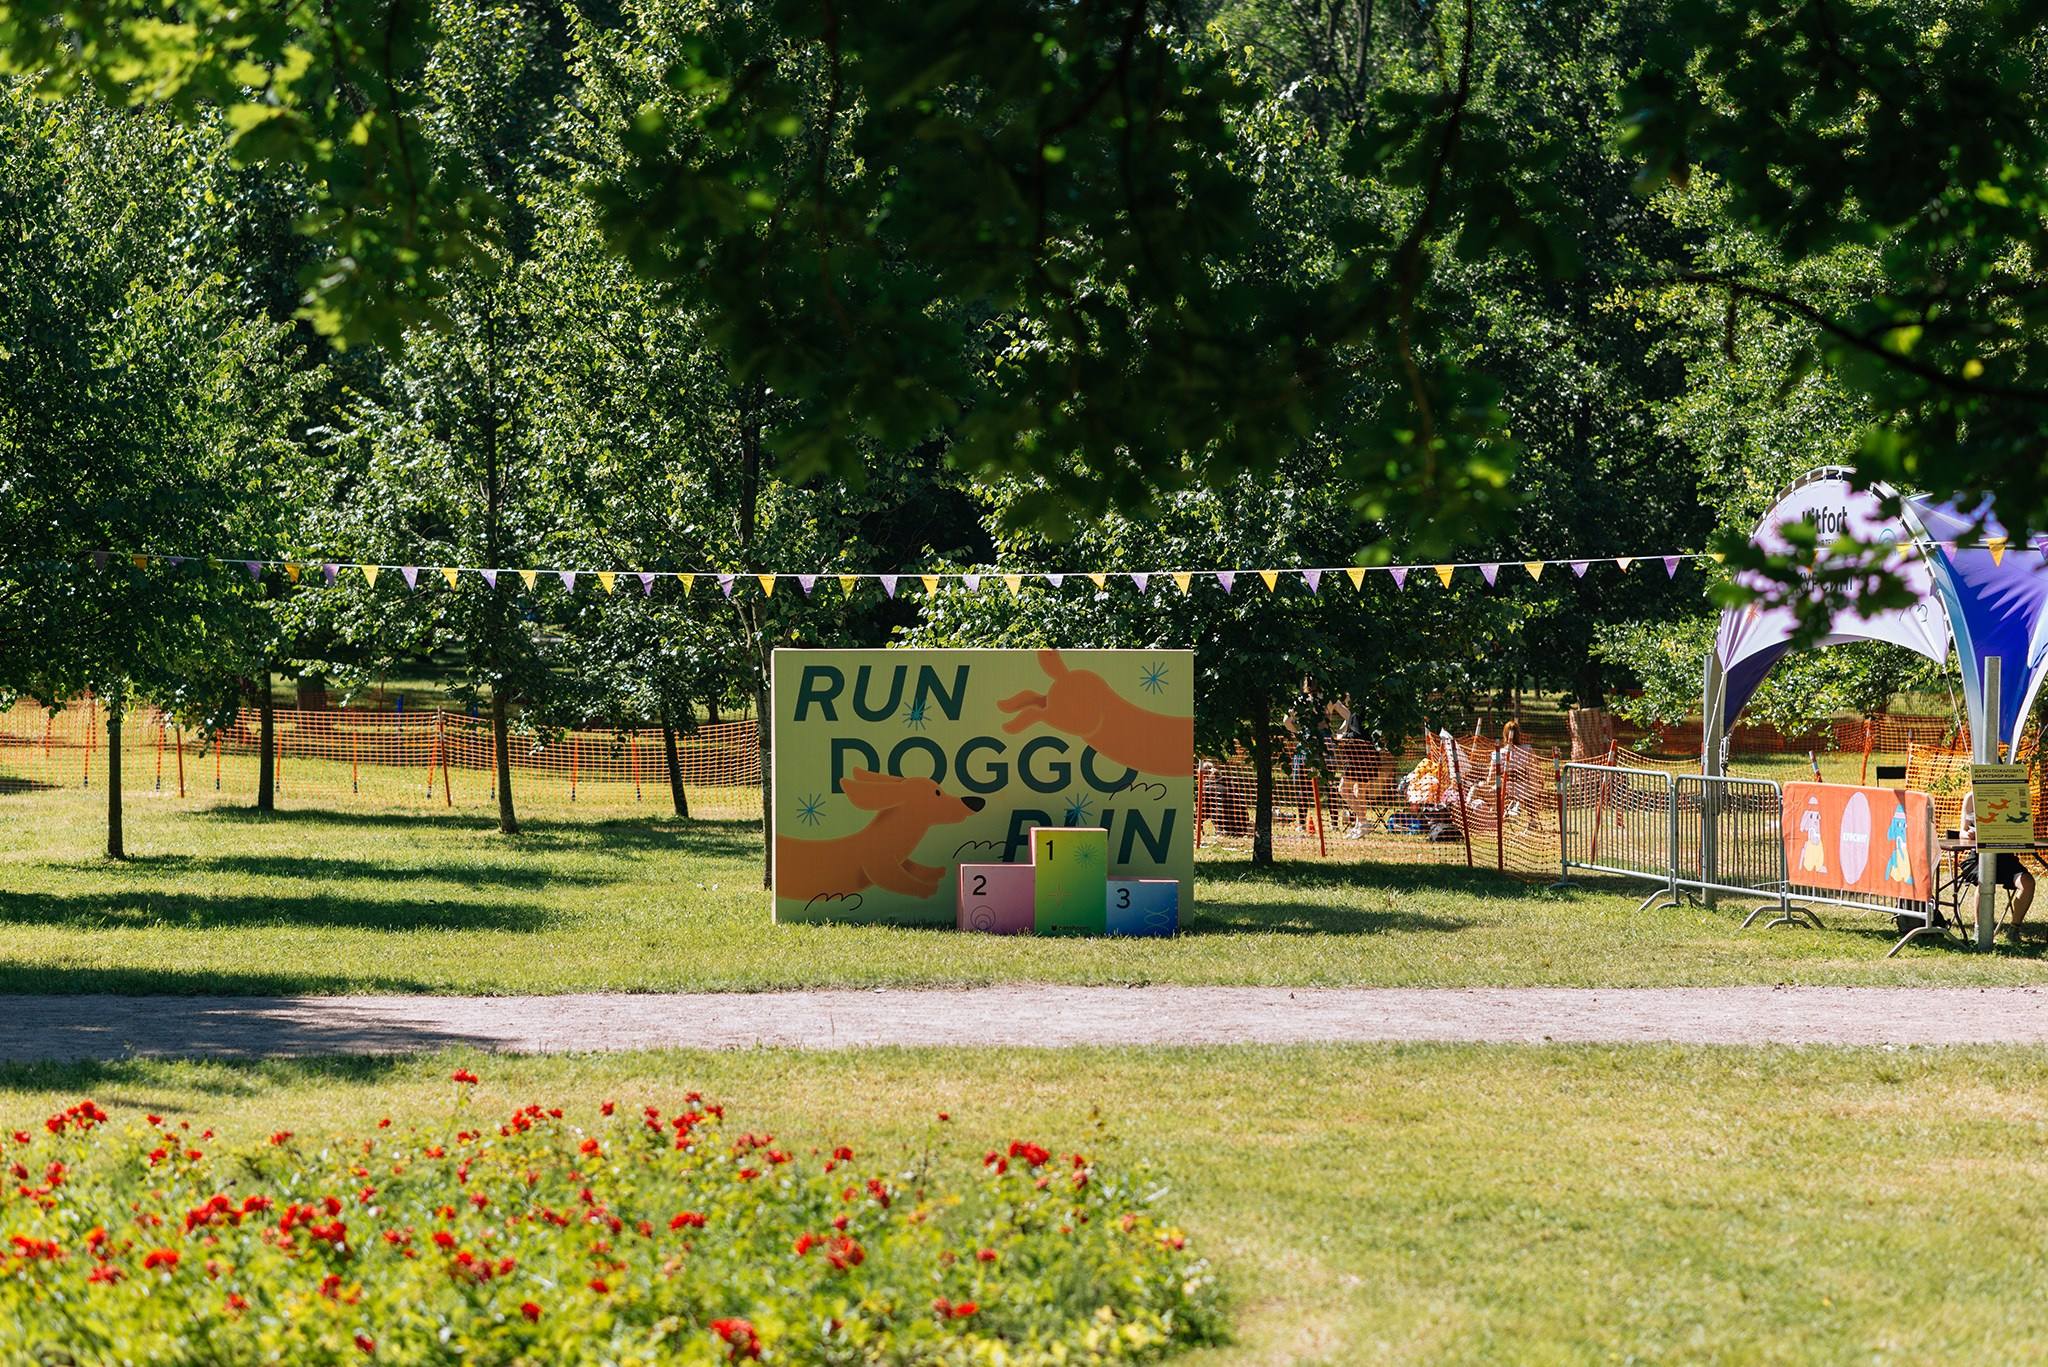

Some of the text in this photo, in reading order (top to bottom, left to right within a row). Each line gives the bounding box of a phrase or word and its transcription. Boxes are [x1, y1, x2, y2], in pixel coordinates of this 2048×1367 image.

[793, 665, 970, 722] RUN
[830, 736, 1138, 794] DOGGO
[1045, 840, 1054, 861] 1
[972, 875, 988, 896] 2
[1116, 888, 1131, 909] 3
